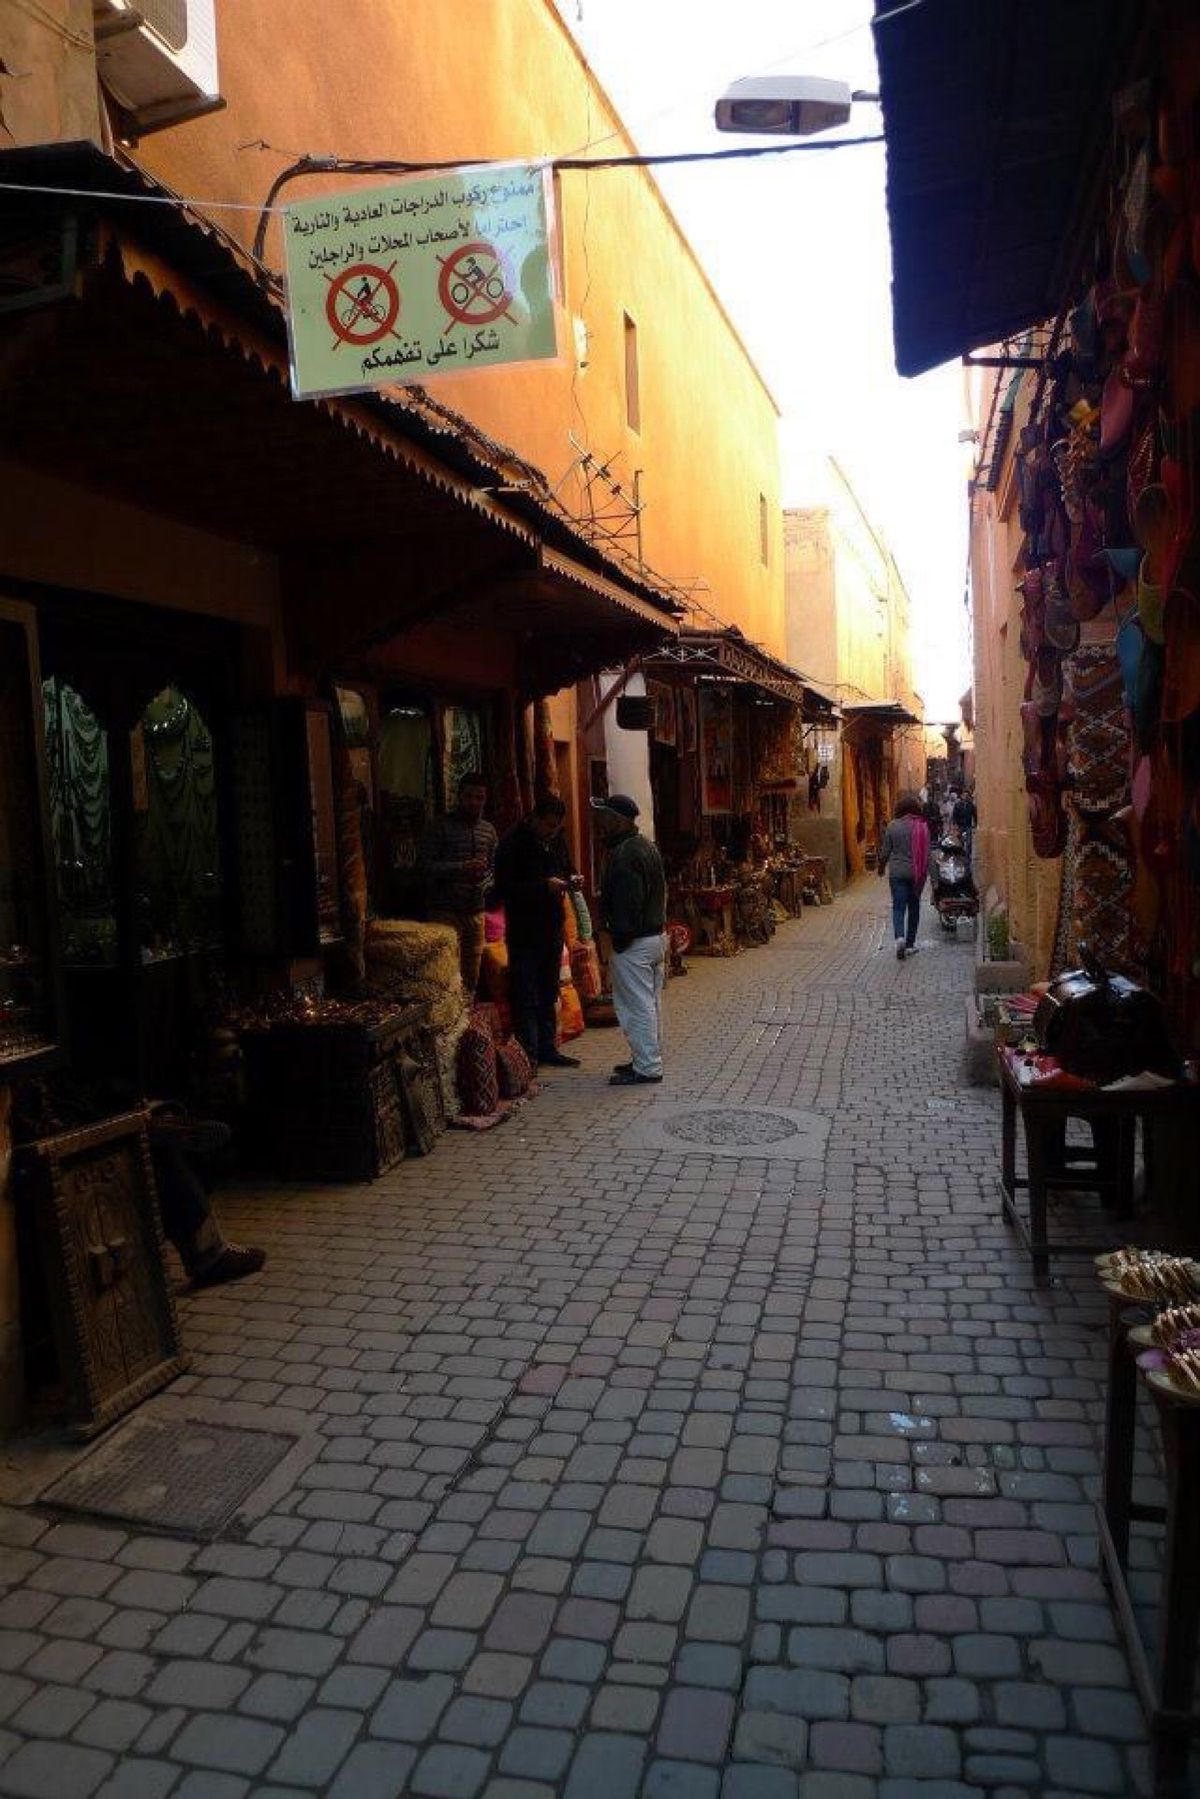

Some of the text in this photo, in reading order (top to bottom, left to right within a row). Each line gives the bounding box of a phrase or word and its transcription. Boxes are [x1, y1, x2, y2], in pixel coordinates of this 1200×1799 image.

[391, 189, 448, 217] الدراجات
[452, 184, 488, 208] ركوب
[292, 211, 340, 236] والنارية
[343, 202, 387, 228] العادية
[368, 232, 412, 254] المحلات
[416, 218, 470, 248] لأصحاب
[309, 242, 364, 269] والراجلين
[361, 330, 500, 379] شكرا على تفهمكم
